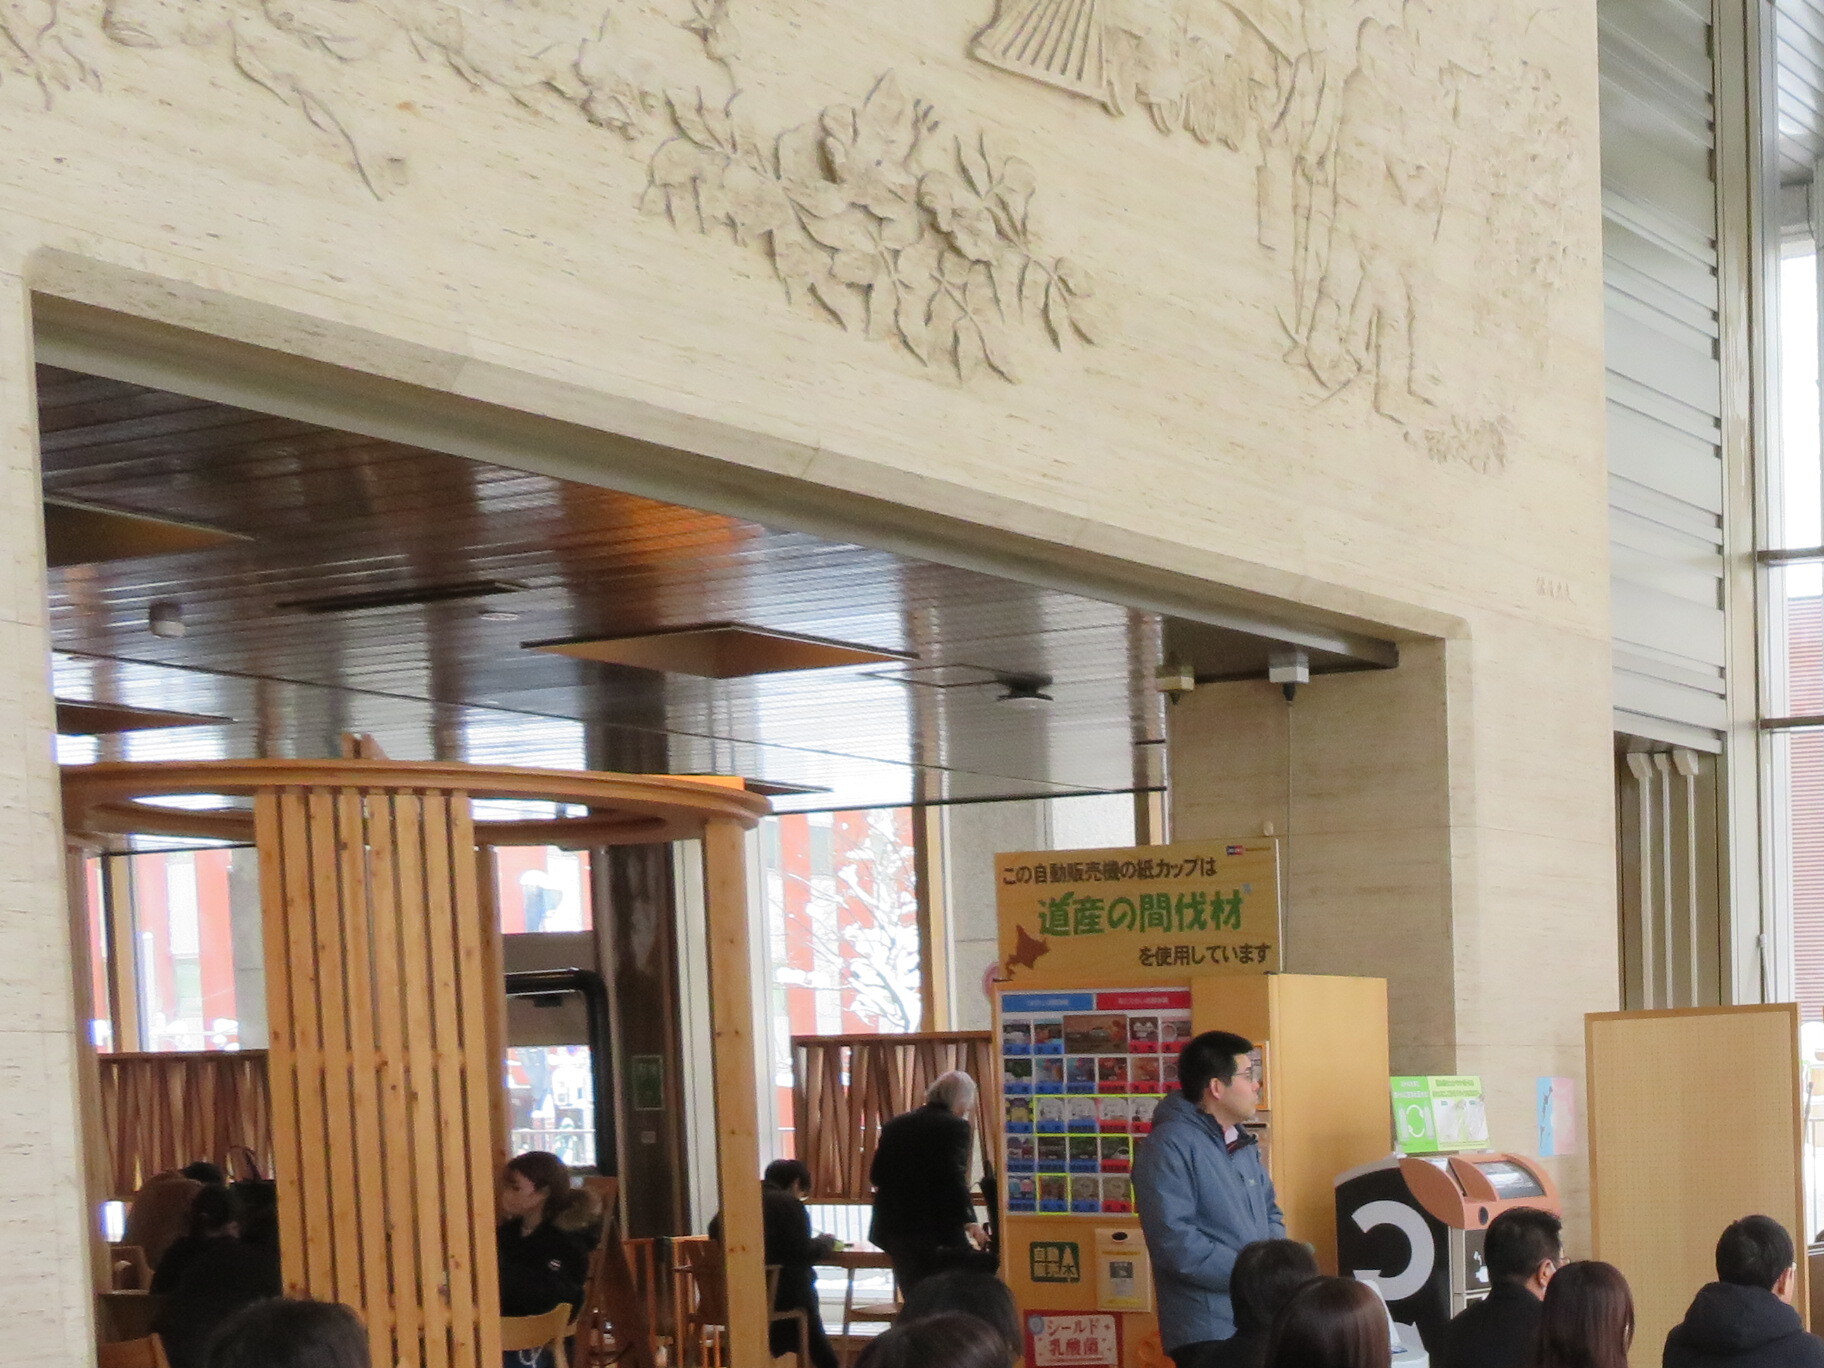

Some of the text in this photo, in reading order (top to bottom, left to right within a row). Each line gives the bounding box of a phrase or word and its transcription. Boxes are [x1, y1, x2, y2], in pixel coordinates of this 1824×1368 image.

[1003, 857, 1218, 885] この自動販売機の紙カップは
[1038, 889, 1243, 937] 道産の間伐材
[1139, 943, 1272, 966] を使用しています
[1047, 1317, 1100, 1337] シールド
